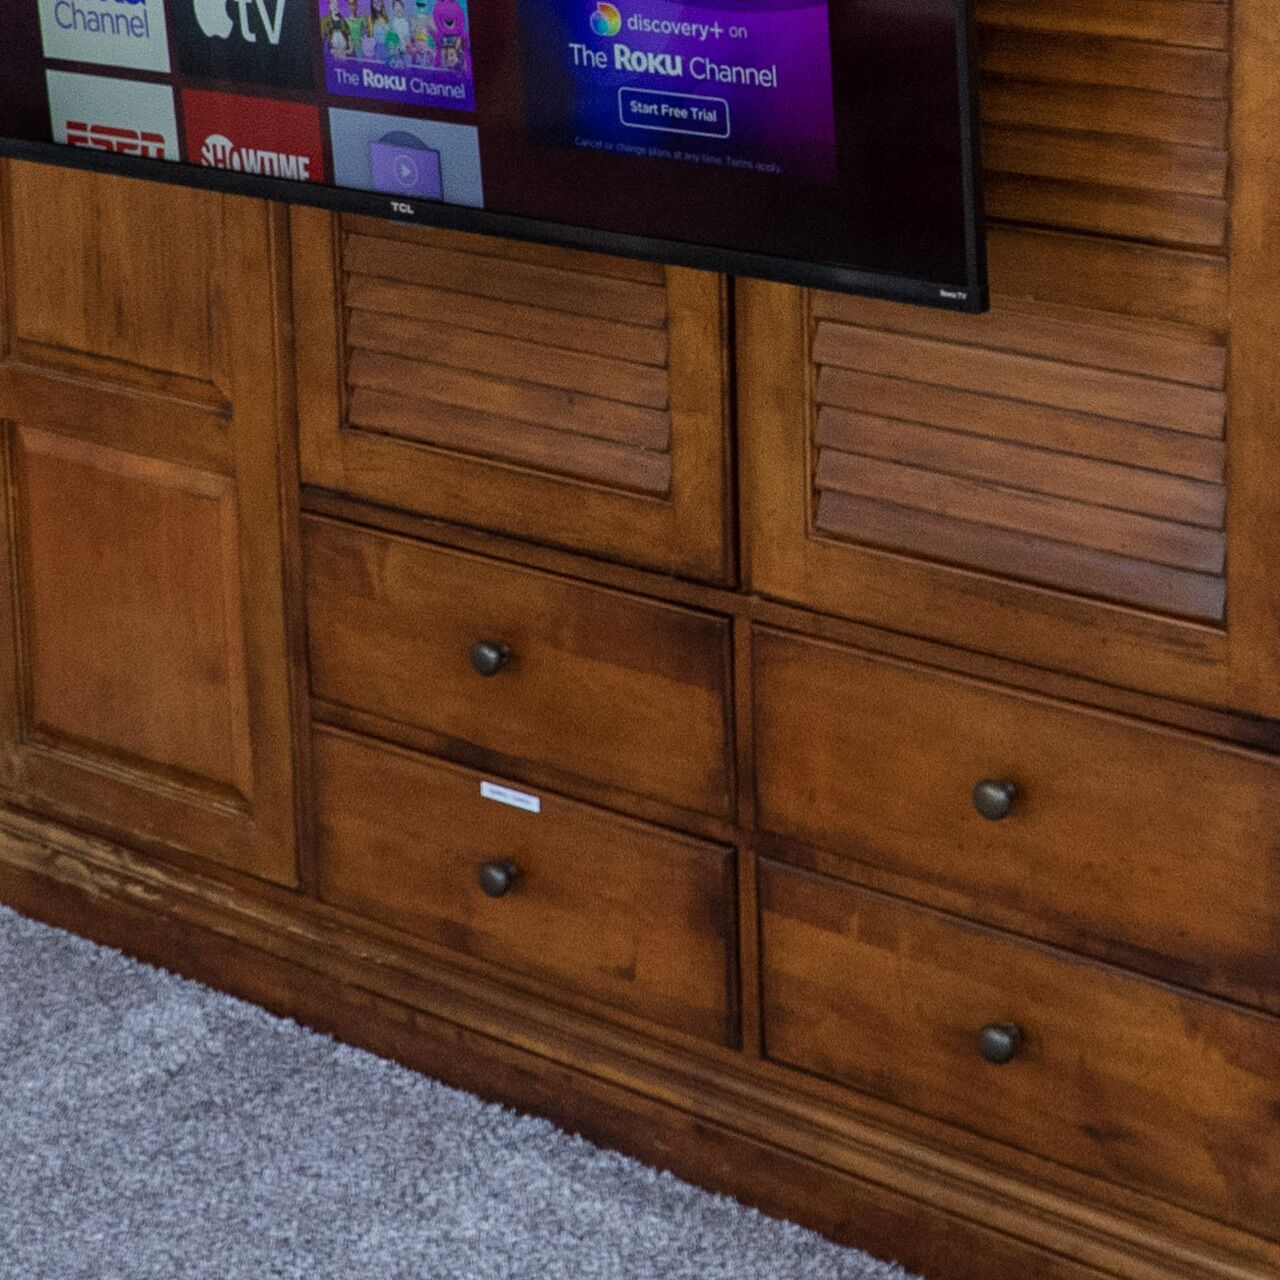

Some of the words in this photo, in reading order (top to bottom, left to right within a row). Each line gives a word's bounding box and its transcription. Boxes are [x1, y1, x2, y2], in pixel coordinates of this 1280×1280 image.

[54, 0, 150, 38] Channel
[627, 14, 723, 41] discovery+
[728, 25, 748, 39] on
[569, 43, 608, 68] The
[613, 43, 683, 77] Roku
[689, 56, 778, 88] Channel
[334, 68, 360, 85] The
[410, 78, 466, 99] Channel
[630, 100, 658, 116] Start
[661, 104, 688, 119] Free
[690, 107, 717, 122] Trial
[390, 201, 414, 215] TCL
